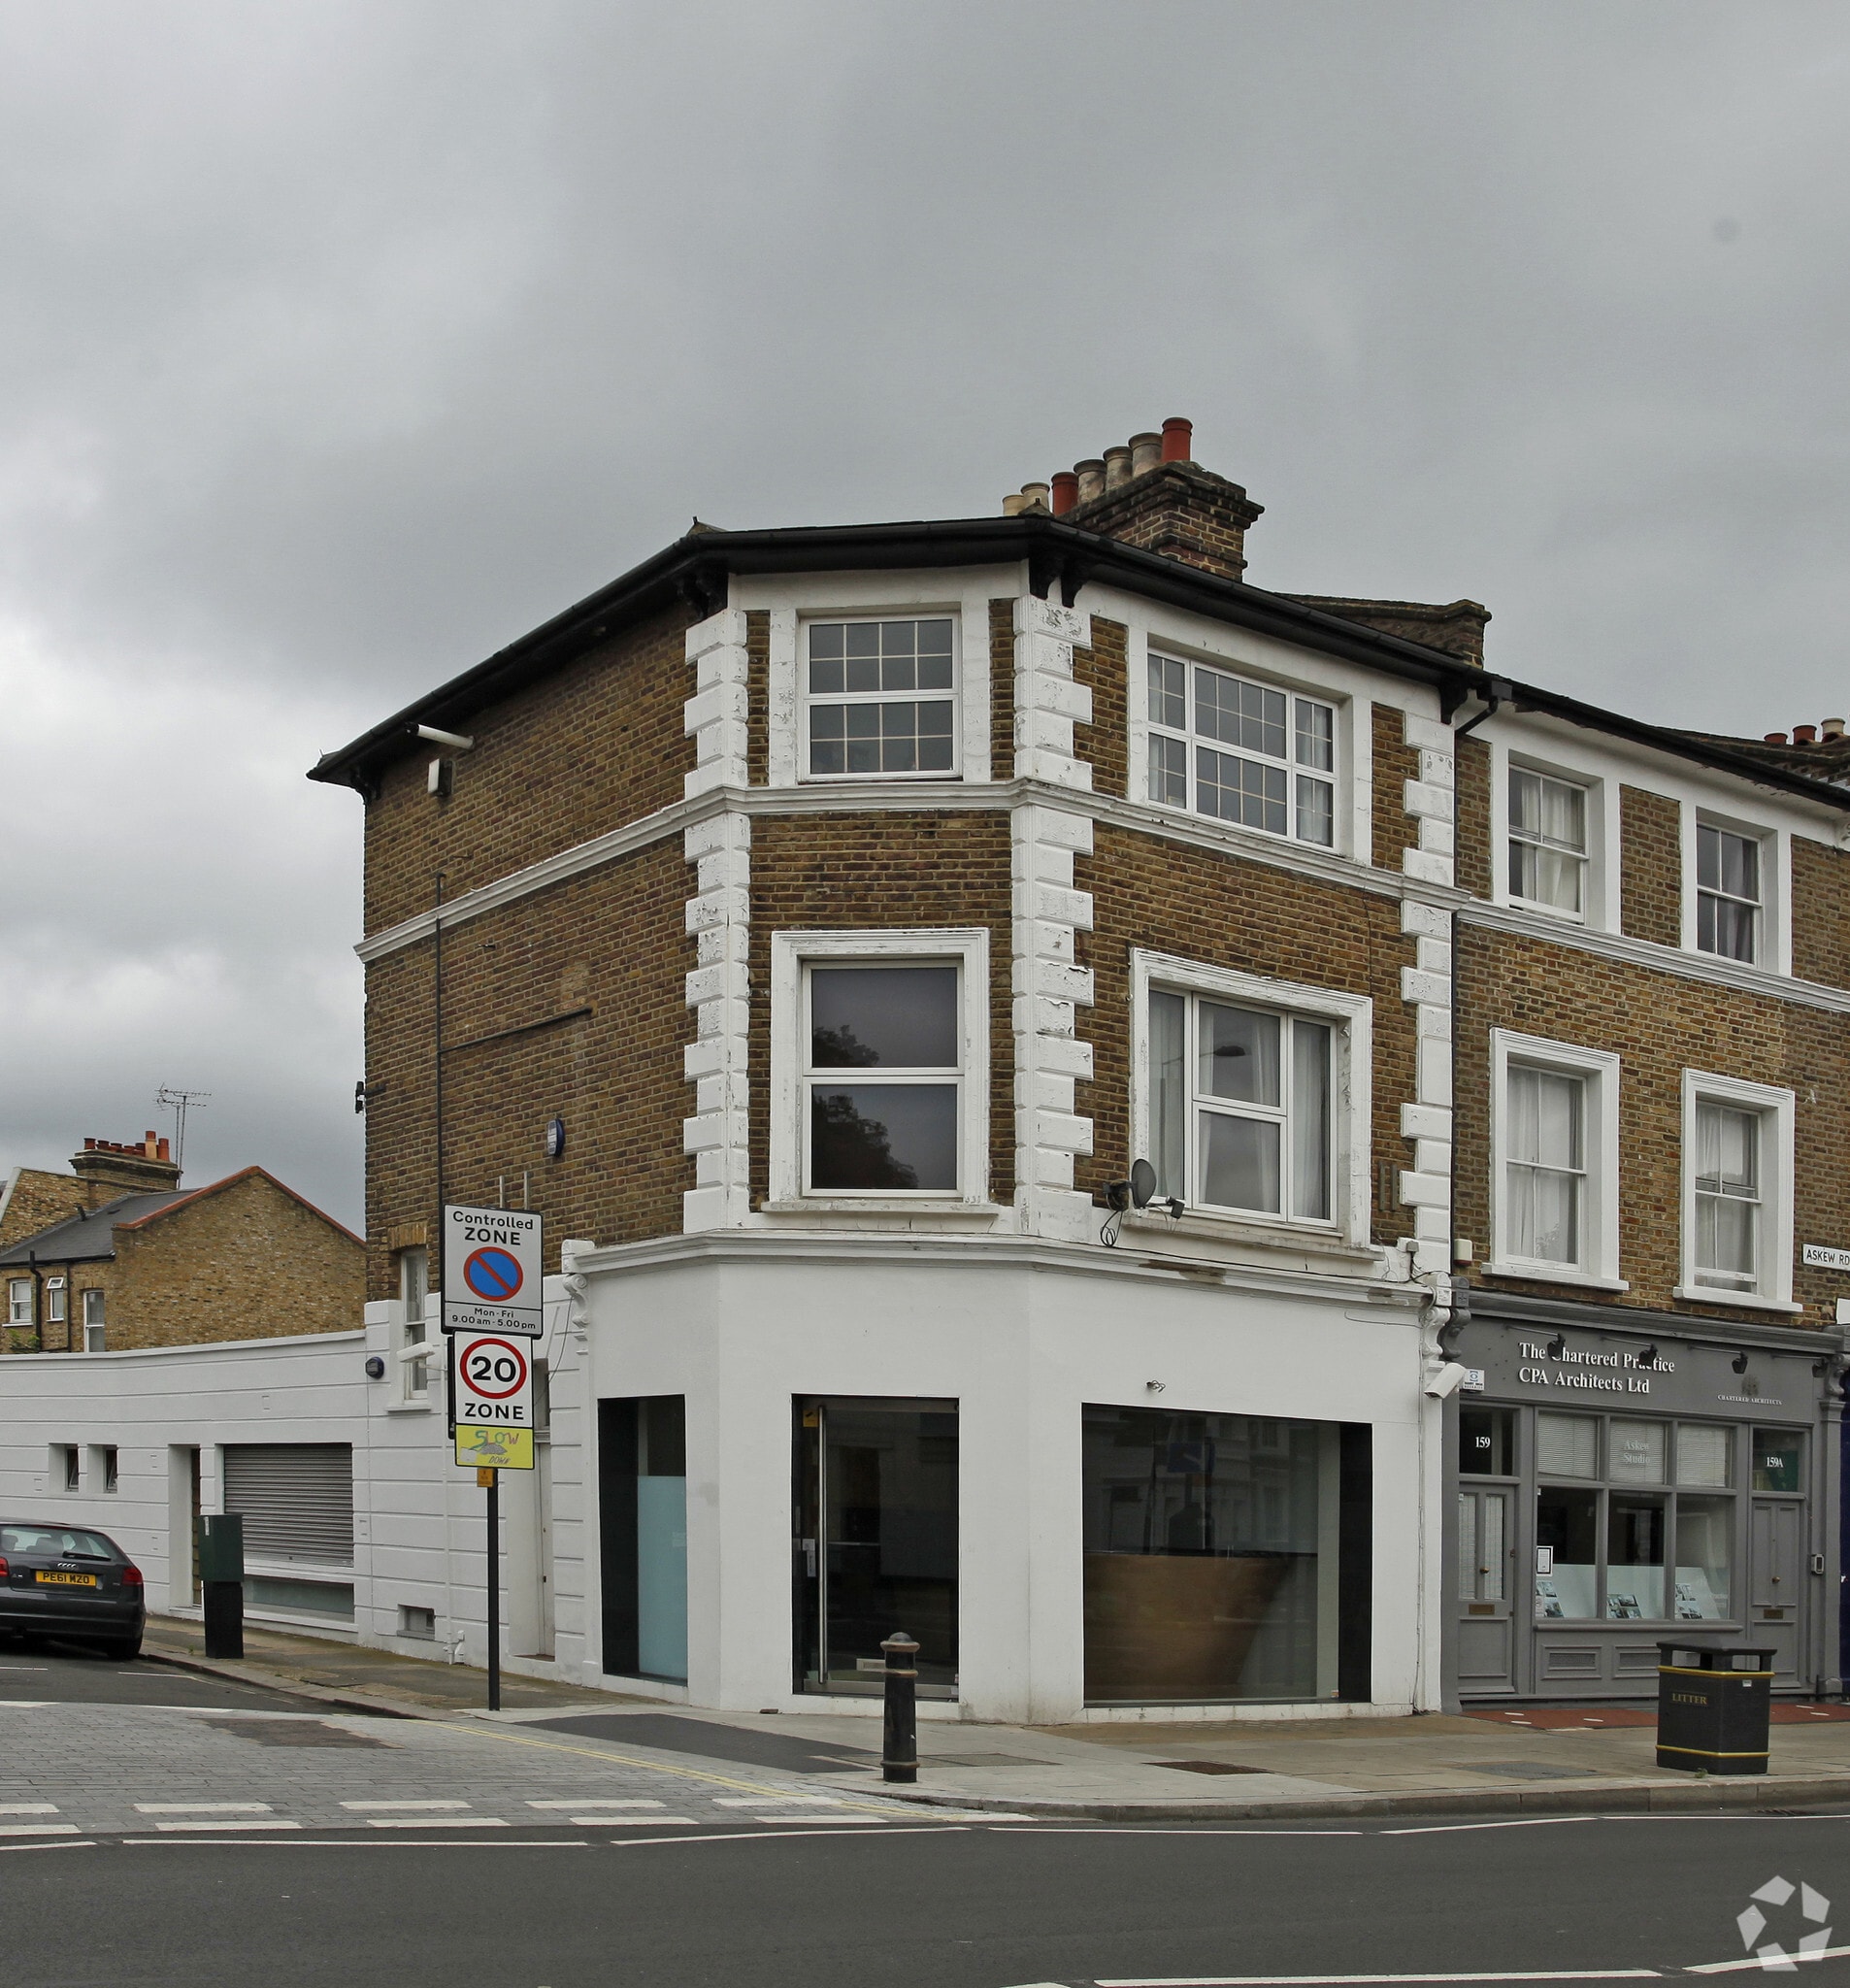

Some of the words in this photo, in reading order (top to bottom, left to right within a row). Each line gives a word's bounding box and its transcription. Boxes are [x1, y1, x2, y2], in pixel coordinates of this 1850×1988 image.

[453, 1211, 533, 1230] Controlled
[465, 1227, 521, 1245] ZONE
[1806, 1249, 1835, 1263] ASKEW
[1519, 1342, 1546, 1359] The
[1551, 1346, 1618, 1367] hartered
[1623, 1353, 1675, 1373] Prtice
[471, 1356, 516, 1382] 20
[1519, 1367, 1549, 1384] CPA
[1555, 1371, 1623, 1391] Architects
[1628, 1377, 1650, 1394] Ltd
[464, 1403, 524, 1420] ZONE
[472, 1430, 519, 1447] SLOW
[1475, 1437, 1491, 1448] 159
[1624, 1453, 1650, 1464] Studio
[1766, 1457, 1784, 1468] 159A
[43, 1573, 67, 1582] PE61
[1671, 1693, 1707, 1706] LITTER
